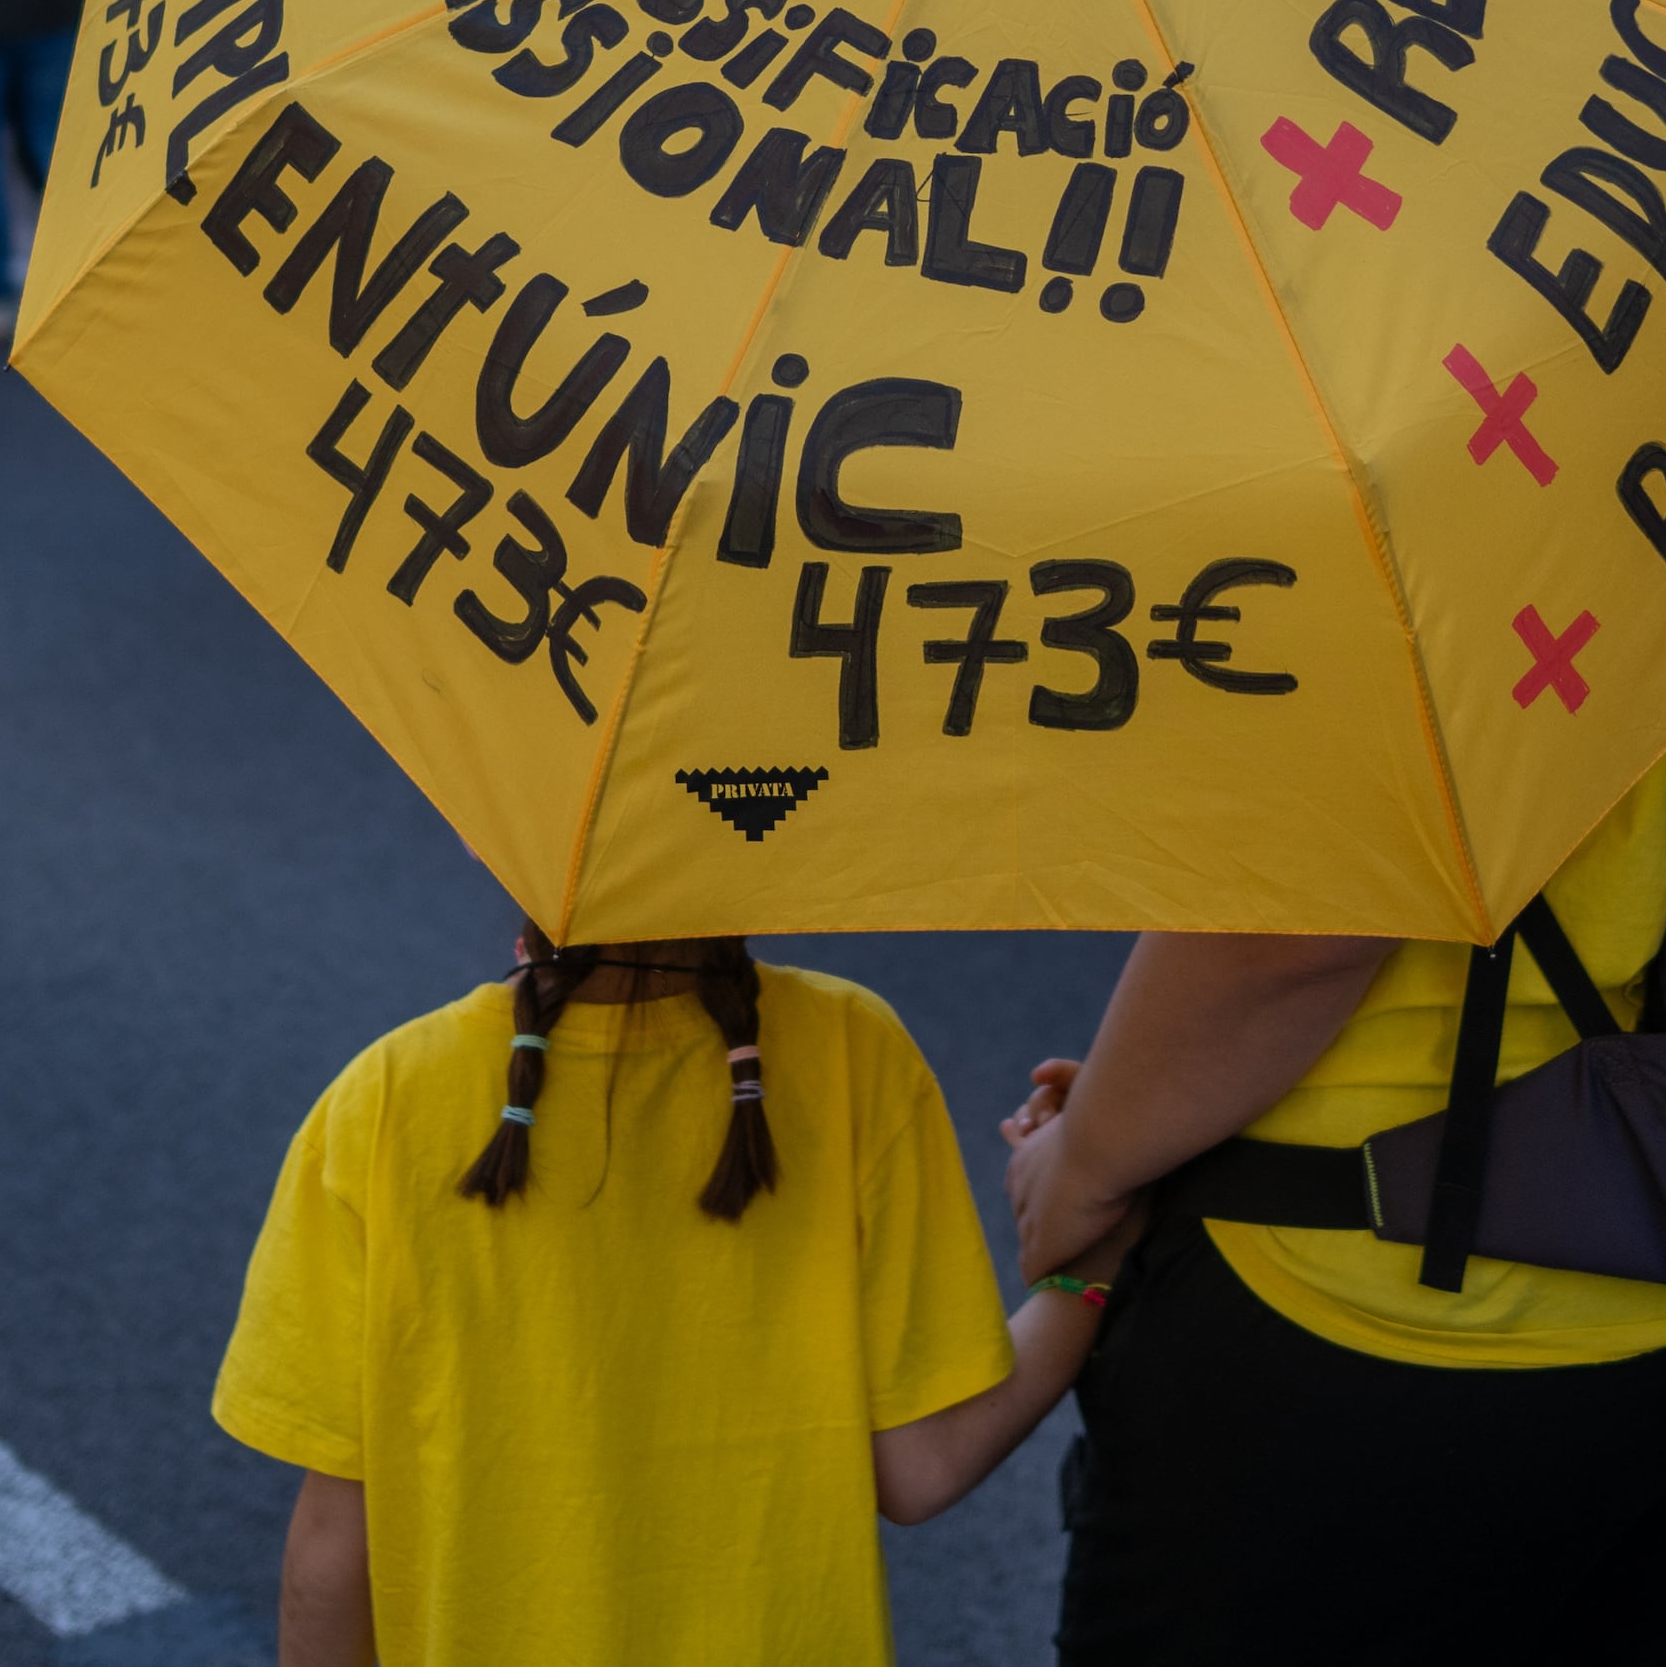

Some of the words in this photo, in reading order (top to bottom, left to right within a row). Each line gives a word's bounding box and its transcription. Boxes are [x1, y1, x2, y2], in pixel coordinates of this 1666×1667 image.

[306, 379, 647, 725] 473€
[789, 556, 1299, 751] 473€
[709, 782, 795, 799] PRIVATA
